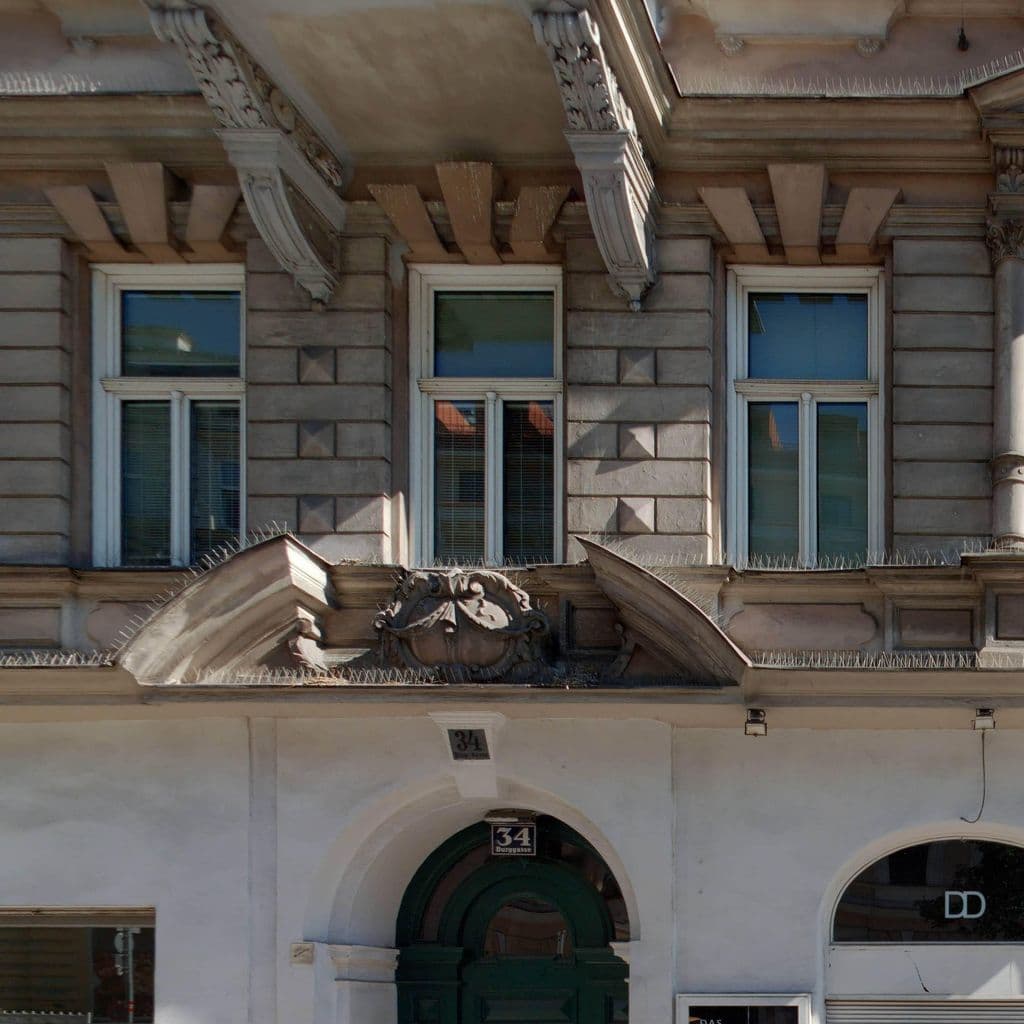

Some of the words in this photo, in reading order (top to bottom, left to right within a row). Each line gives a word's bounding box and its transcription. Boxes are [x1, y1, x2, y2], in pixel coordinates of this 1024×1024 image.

[455, 730, 483, 752] 34
[496, 827, 531, 847] 34
[944, 890, 986, 919] DD
